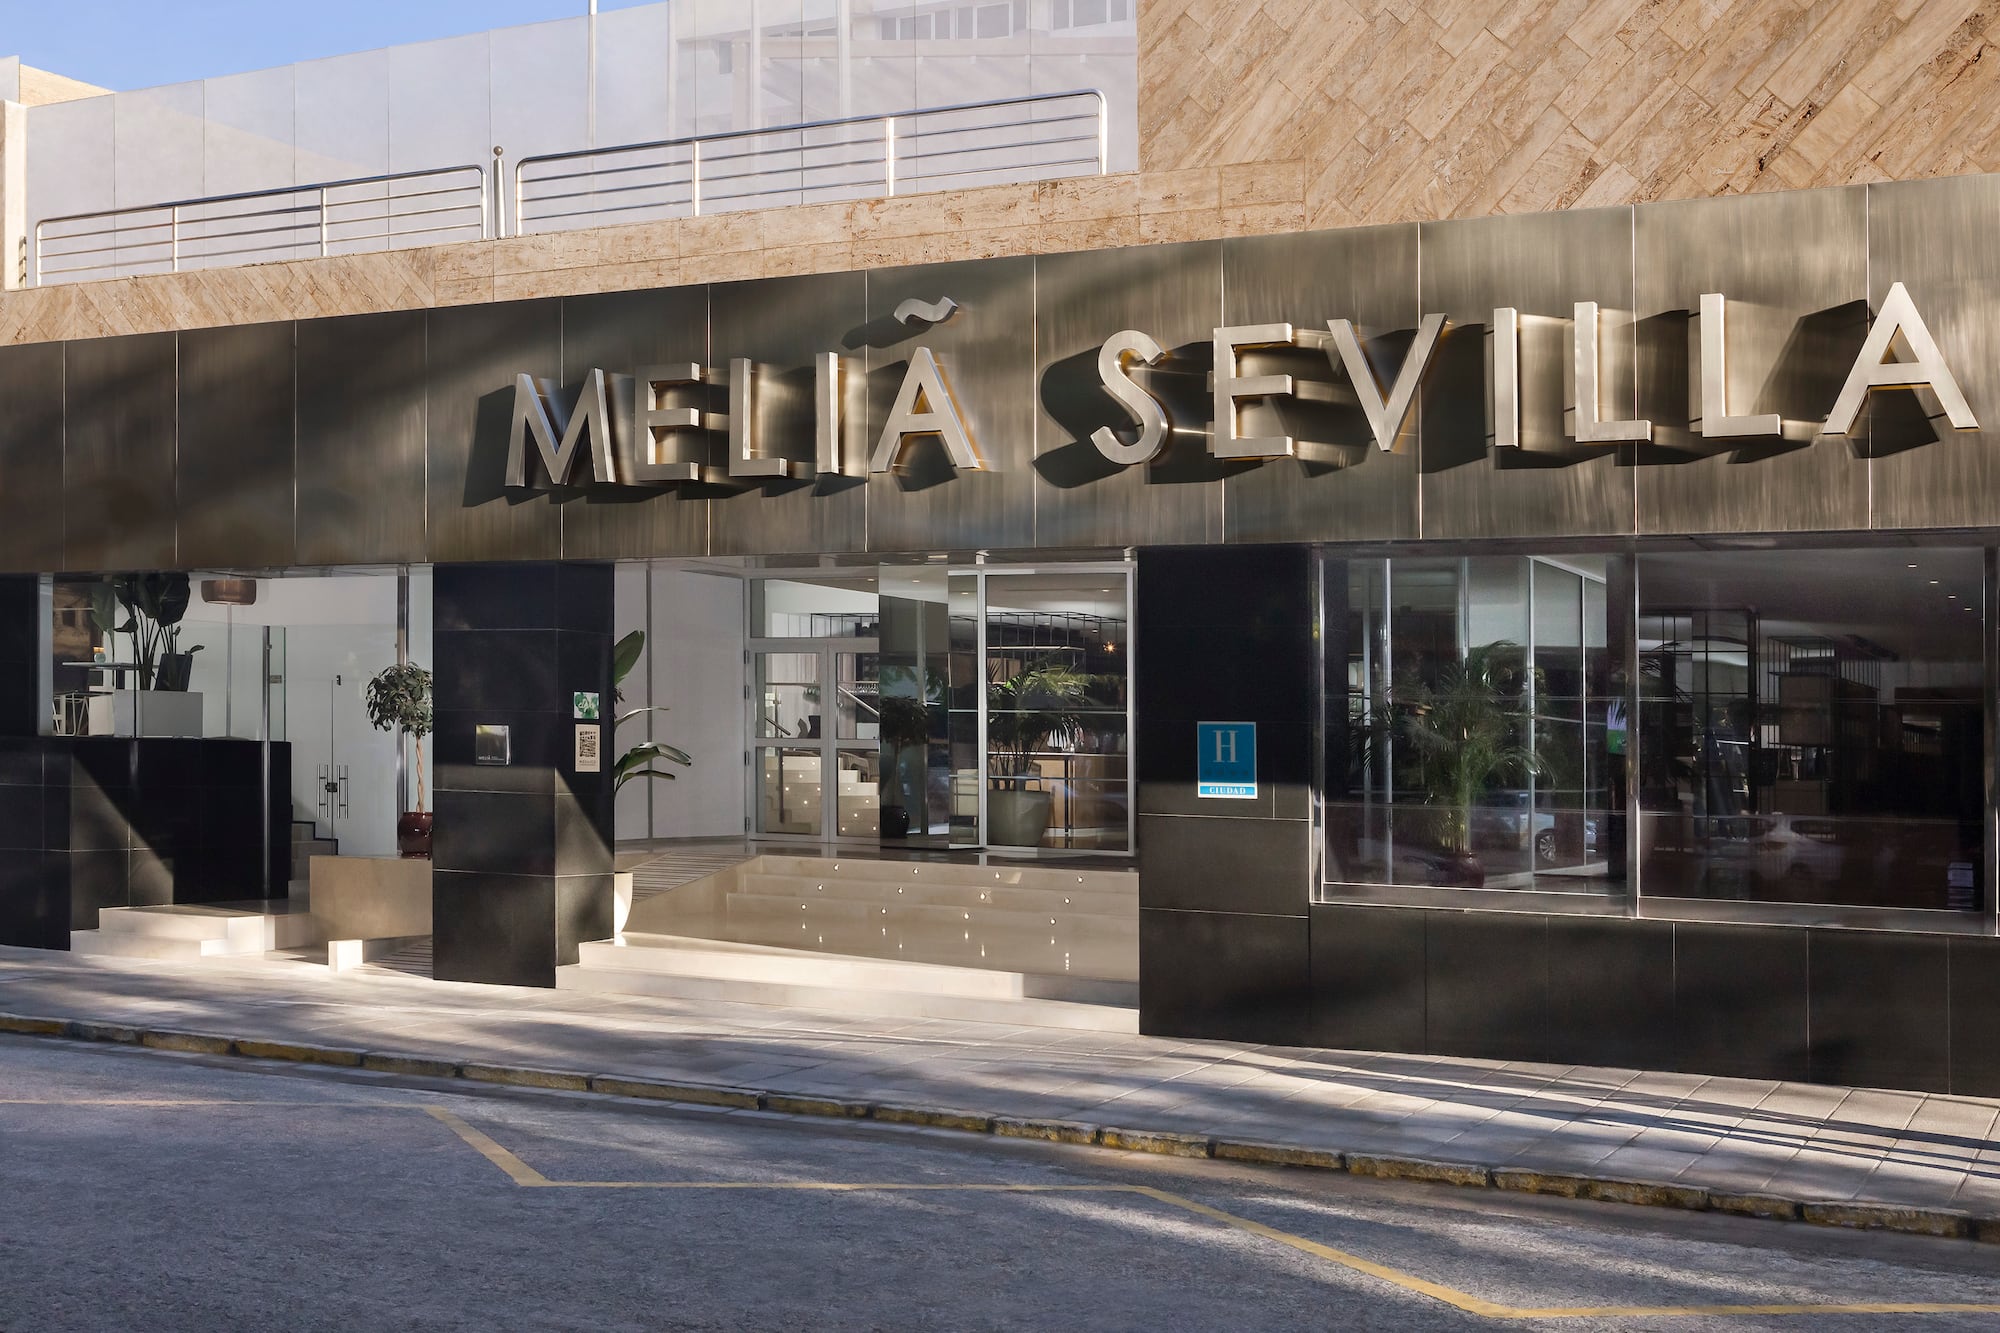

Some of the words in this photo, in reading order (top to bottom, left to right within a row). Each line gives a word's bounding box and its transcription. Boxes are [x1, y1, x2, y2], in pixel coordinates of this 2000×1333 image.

[1089, 281, 1981, 465] SEVILLA
[1212, 729, 1240, 763] H
[1209, 786, 1246, 795] CIUDAD
